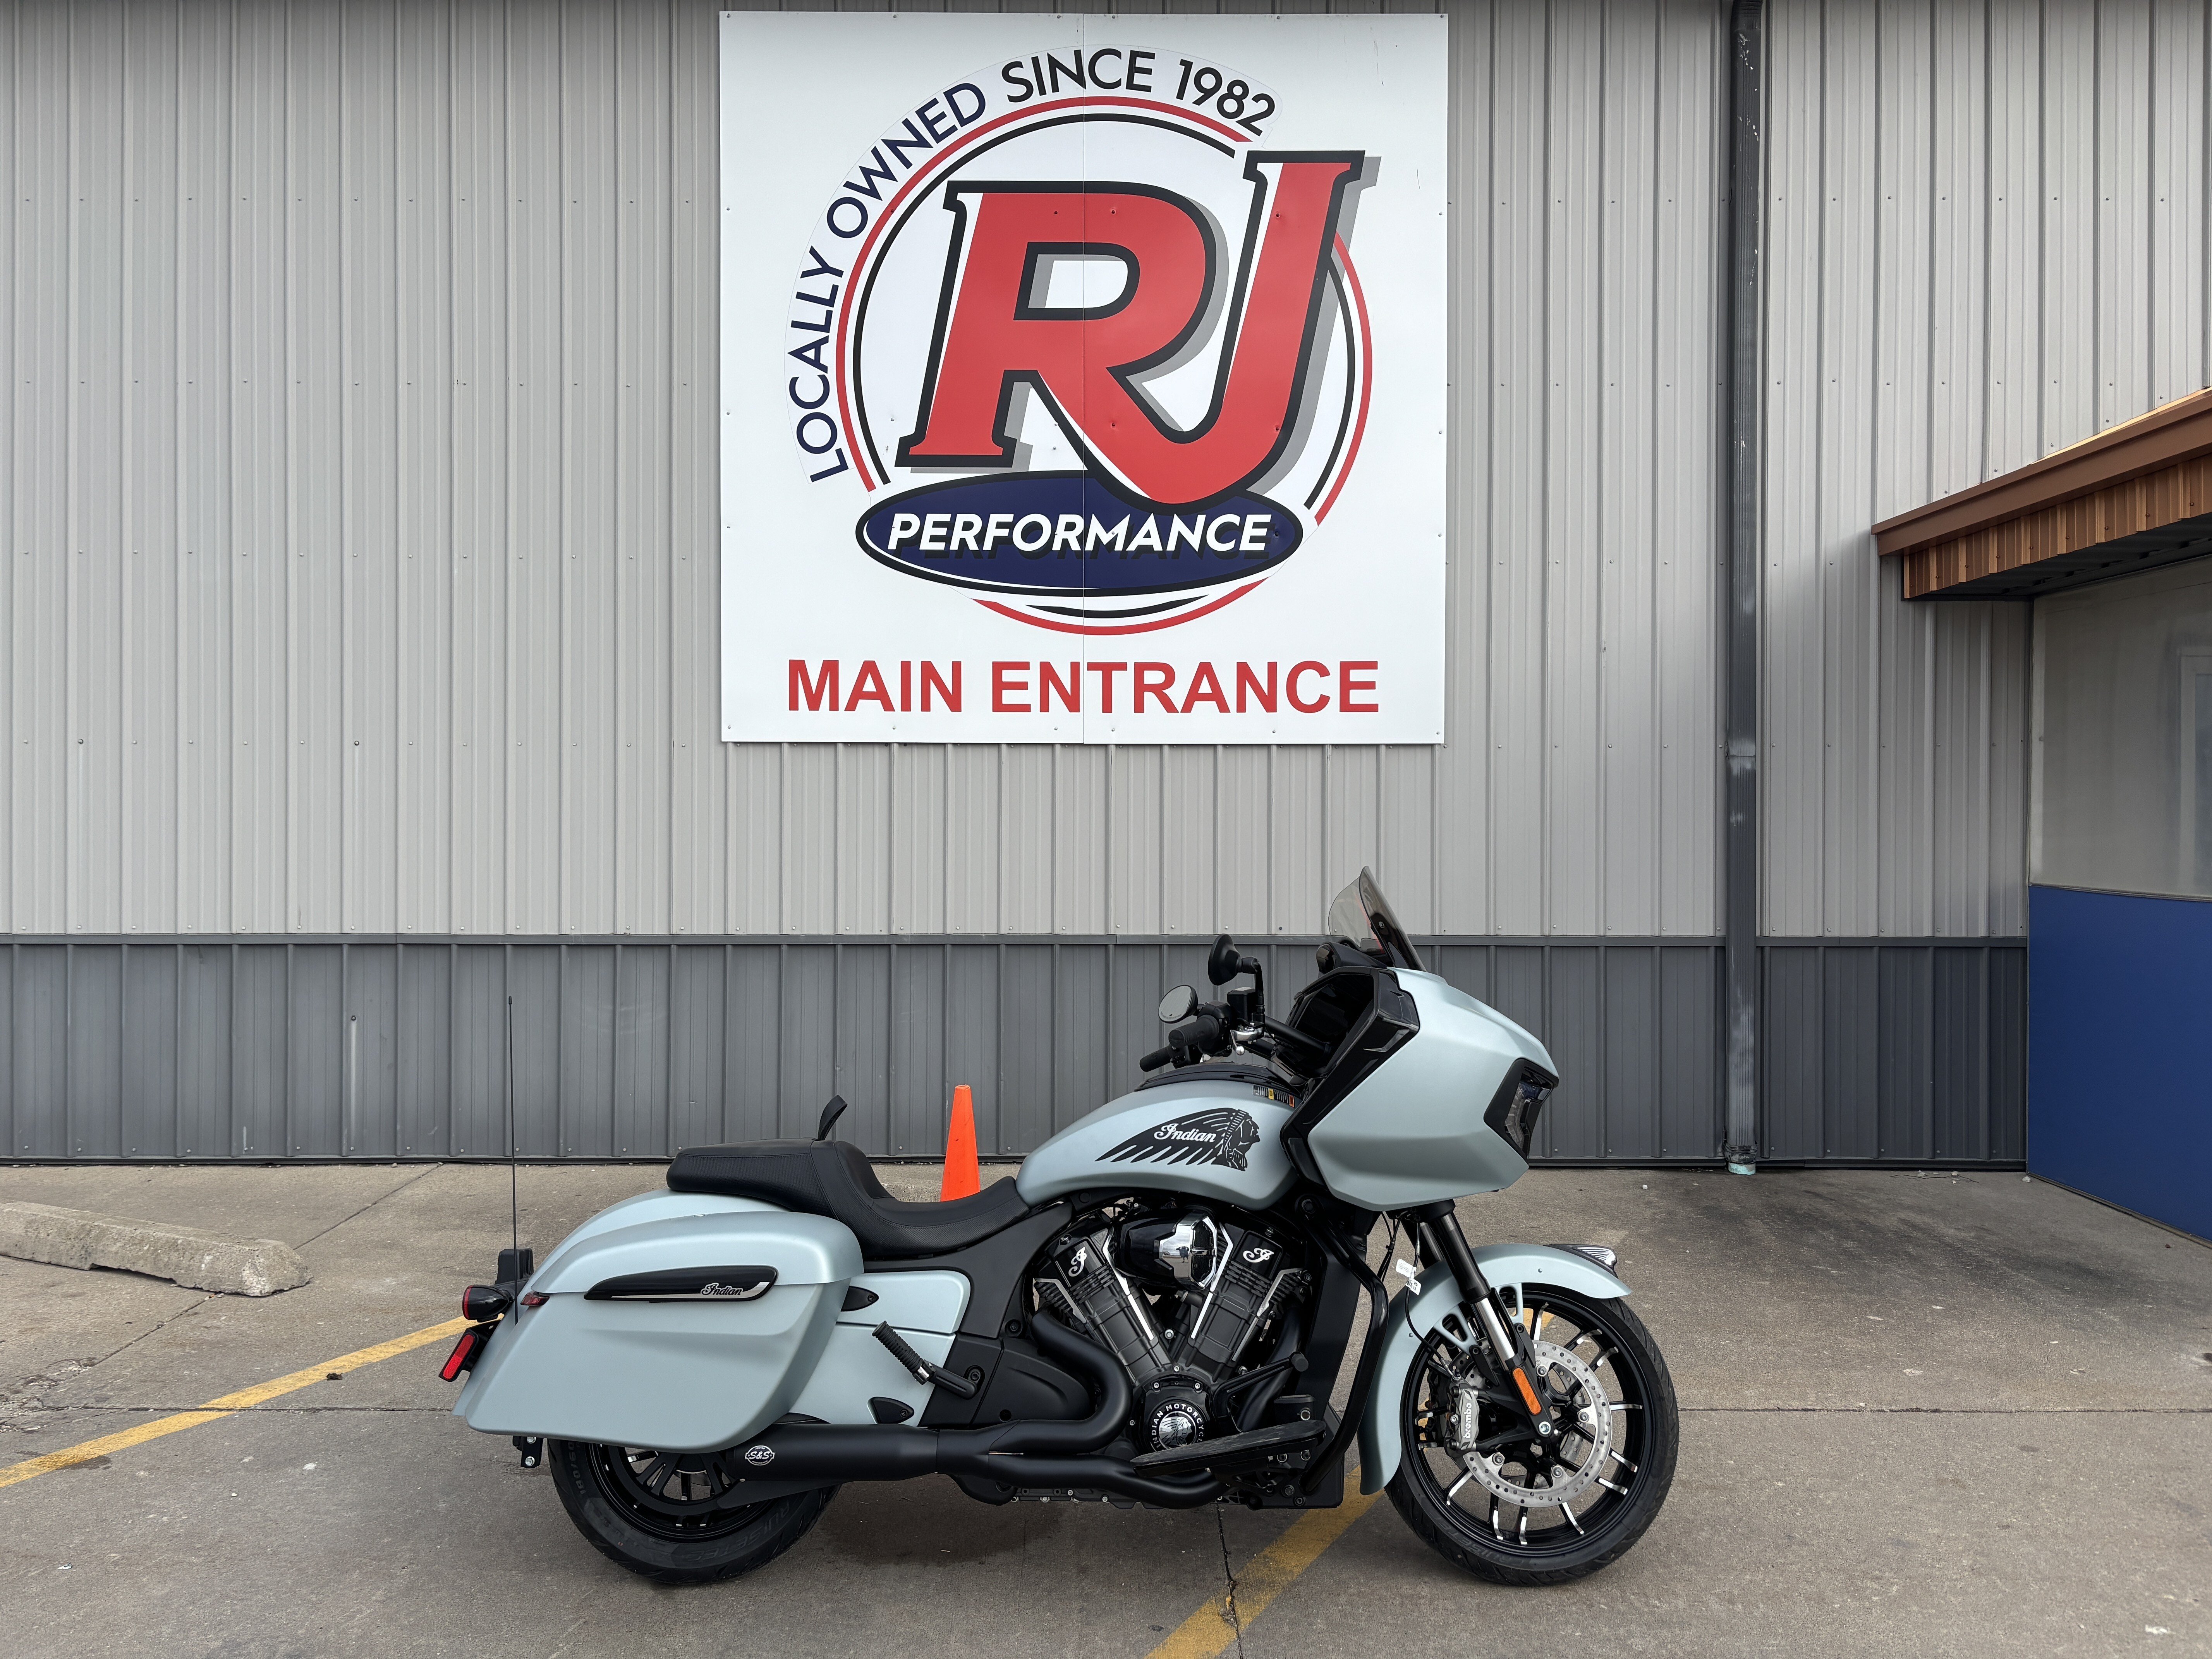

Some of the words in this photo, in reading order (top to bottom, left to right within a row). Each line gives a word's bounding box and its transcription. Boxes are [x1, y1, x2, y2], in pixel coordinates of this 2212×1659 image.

[788, 246, 848, 482] LOCALLY
[827, 83, 986, 238] OWNED
[1002, 48, 1155, 102] SINCE
[1176, 59, 1275, 136] 1982
[895, 150, 1365, 514] RJ
[888, 513, 1271, 551] PERFORMANCE
[789, 660, 962, 712] MAIN
[993, 661, 1379, 713] ENTRANCE
[1154, 1123, 1216, 1142] Indian
[701, 1283, 743, 1295] Indian
[1151, 1410, 1164, 1448] INDIAN
[1165, 1403, 1204, 1442] MOTORCYCL
[1463, 1402, 1472, 1438] brembo
[749, 1451, 770, 1460] S&S
[686, 1498, 793, 1562] RUISETEC
